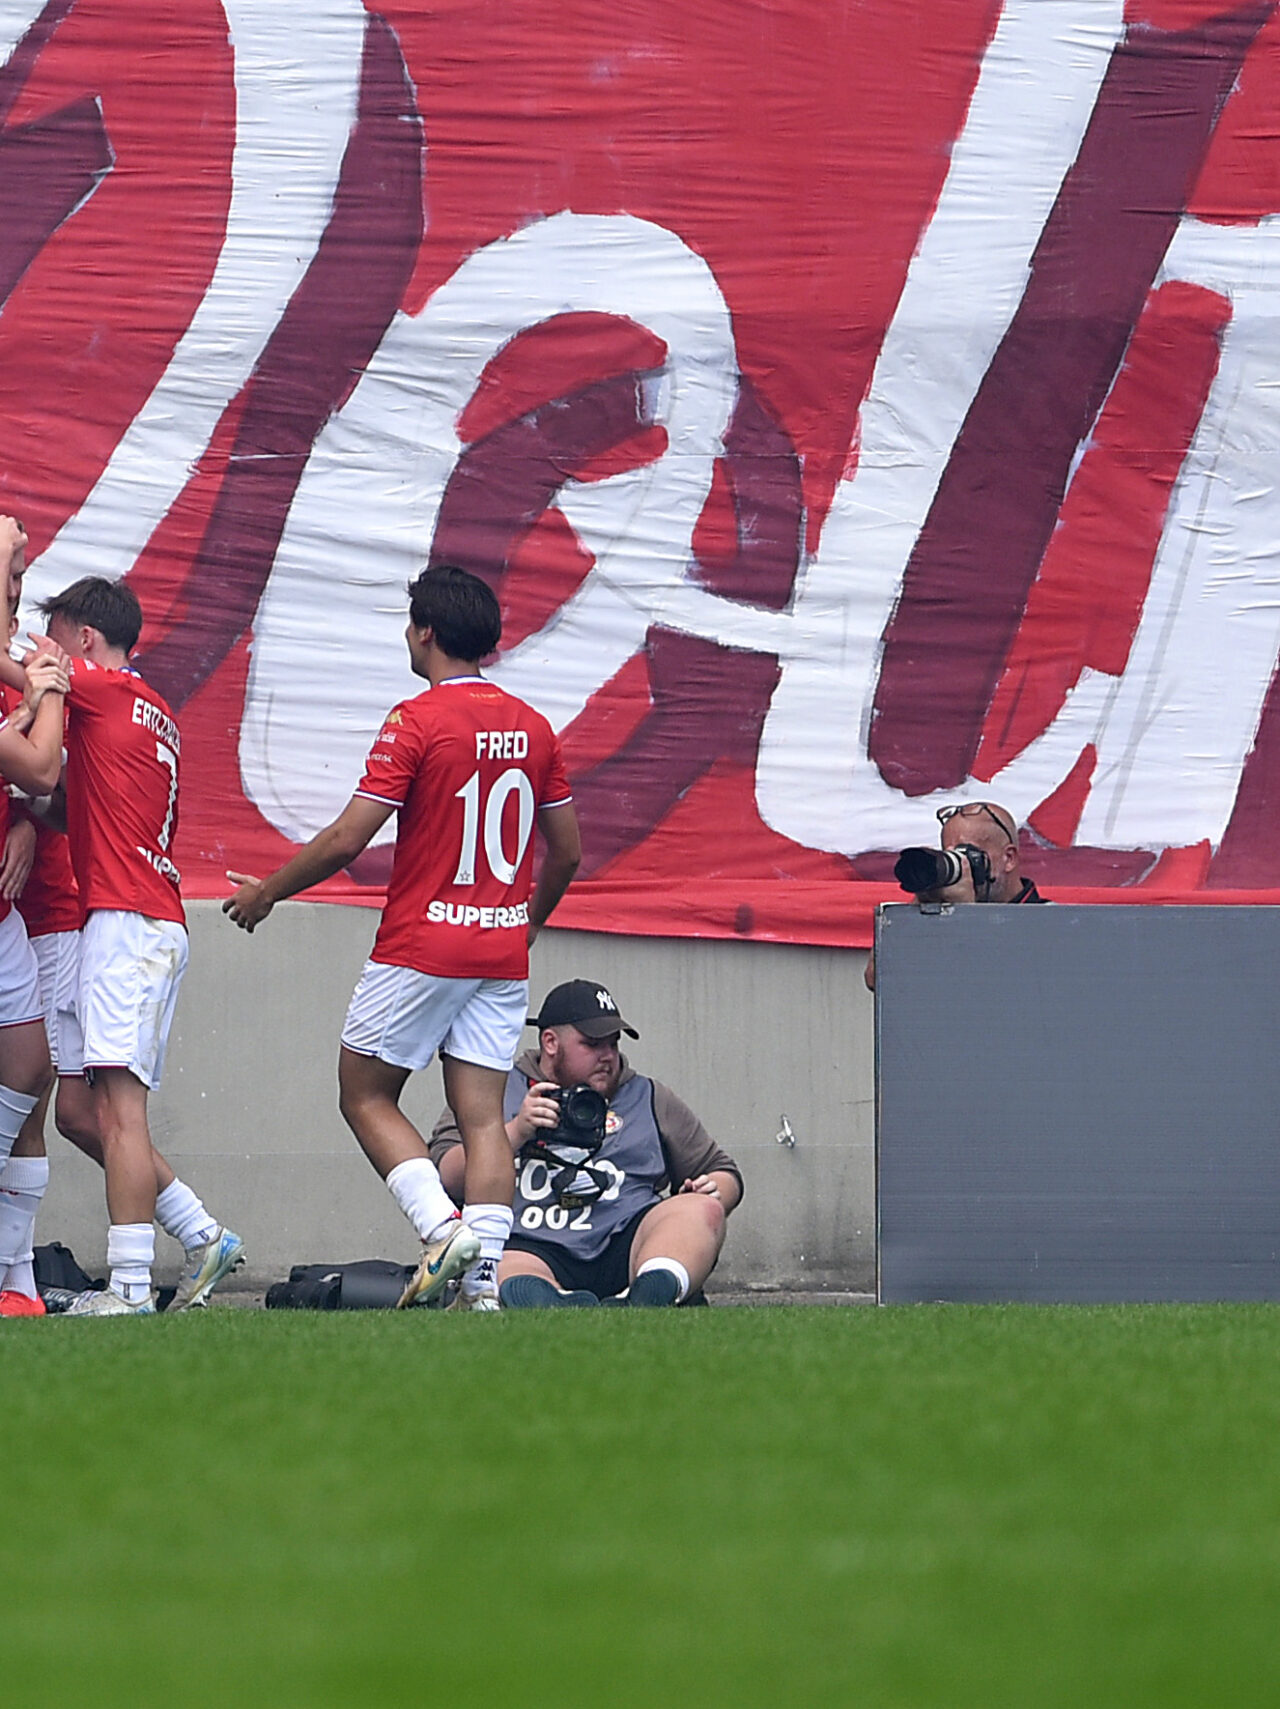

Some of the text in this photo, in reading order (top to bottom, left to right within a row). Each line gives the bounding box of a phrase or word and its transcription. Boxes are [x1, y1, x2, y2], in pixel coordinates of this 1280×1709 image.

[476, 731, 529, 760] FRED
[452, 768, 535, 885] 10
[426, 901, 530, 929] SUPERBET
